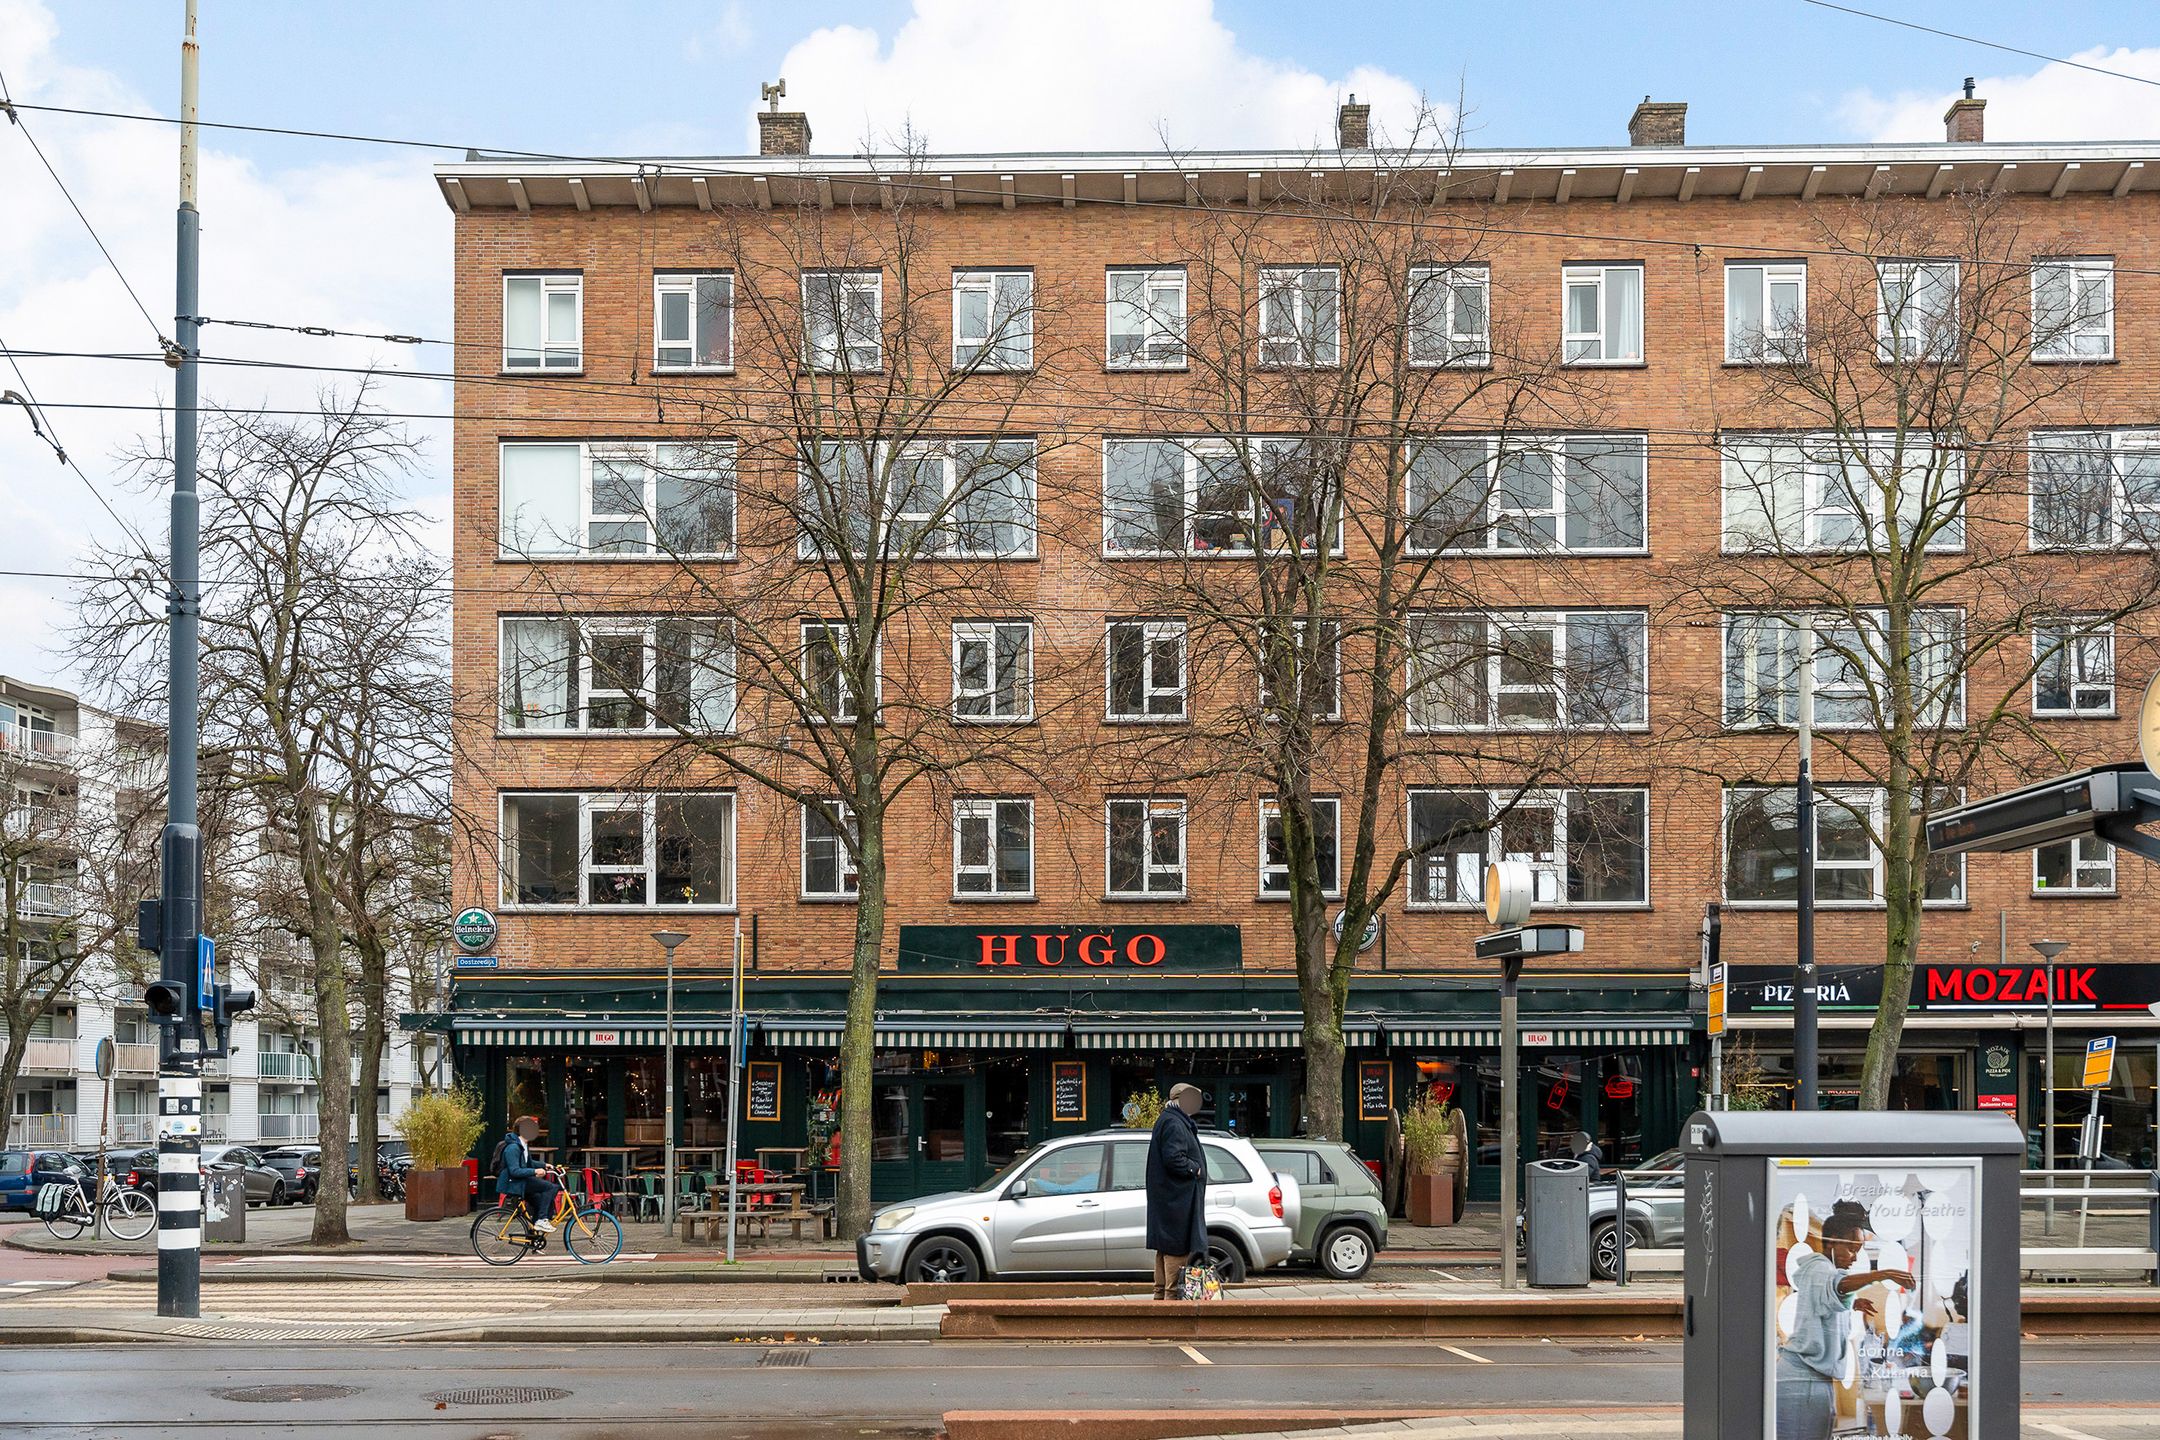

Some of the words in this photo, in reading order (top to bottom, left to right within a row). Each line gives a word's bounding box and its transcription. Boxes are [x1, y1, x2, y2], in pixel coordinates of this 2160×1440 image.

[976, 934, 1166, 966] HUGO
[1927, 968, 2098, 1001] MOZAIK
[1764, 985, 1851, 1002] PIZRIA
[595, 1033, 615, 1041] HUGO
[1528, 1034, 1547, 1042] HUGO
[1985, 1045, 2010, 1055] MOZAIK
[1873, 1204, 1901, 1218] You
[1904, 1203, 1966, 1218] Breathe
[1857, 1345, 1904, 1358] donna
[1871, 1366, 1929, 1379] Kukama
